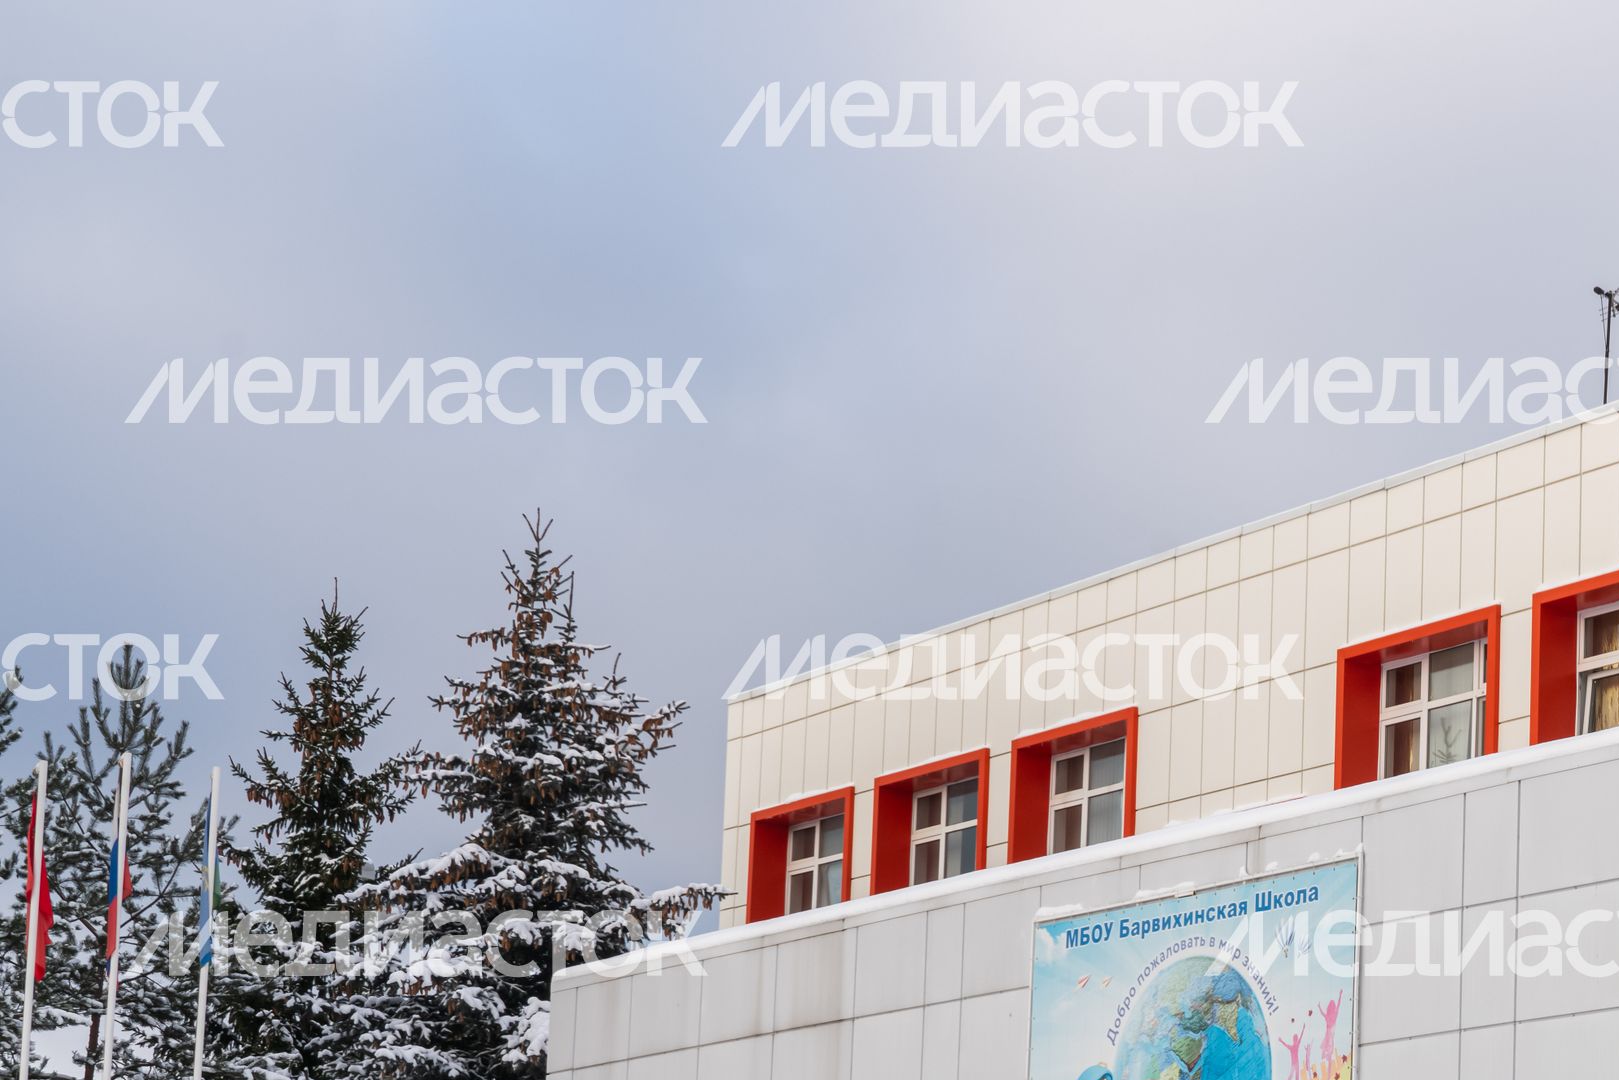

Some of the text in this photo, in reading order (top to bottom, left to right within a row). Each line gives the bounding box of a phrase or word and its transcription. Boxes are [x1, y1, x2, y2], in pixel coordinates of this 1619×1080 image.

[1066, 886, 1319, 948] МБОУ Барвихинская Школа
[1107, 936, 1279, 1046] Добро пожаловать в мир знаний!
